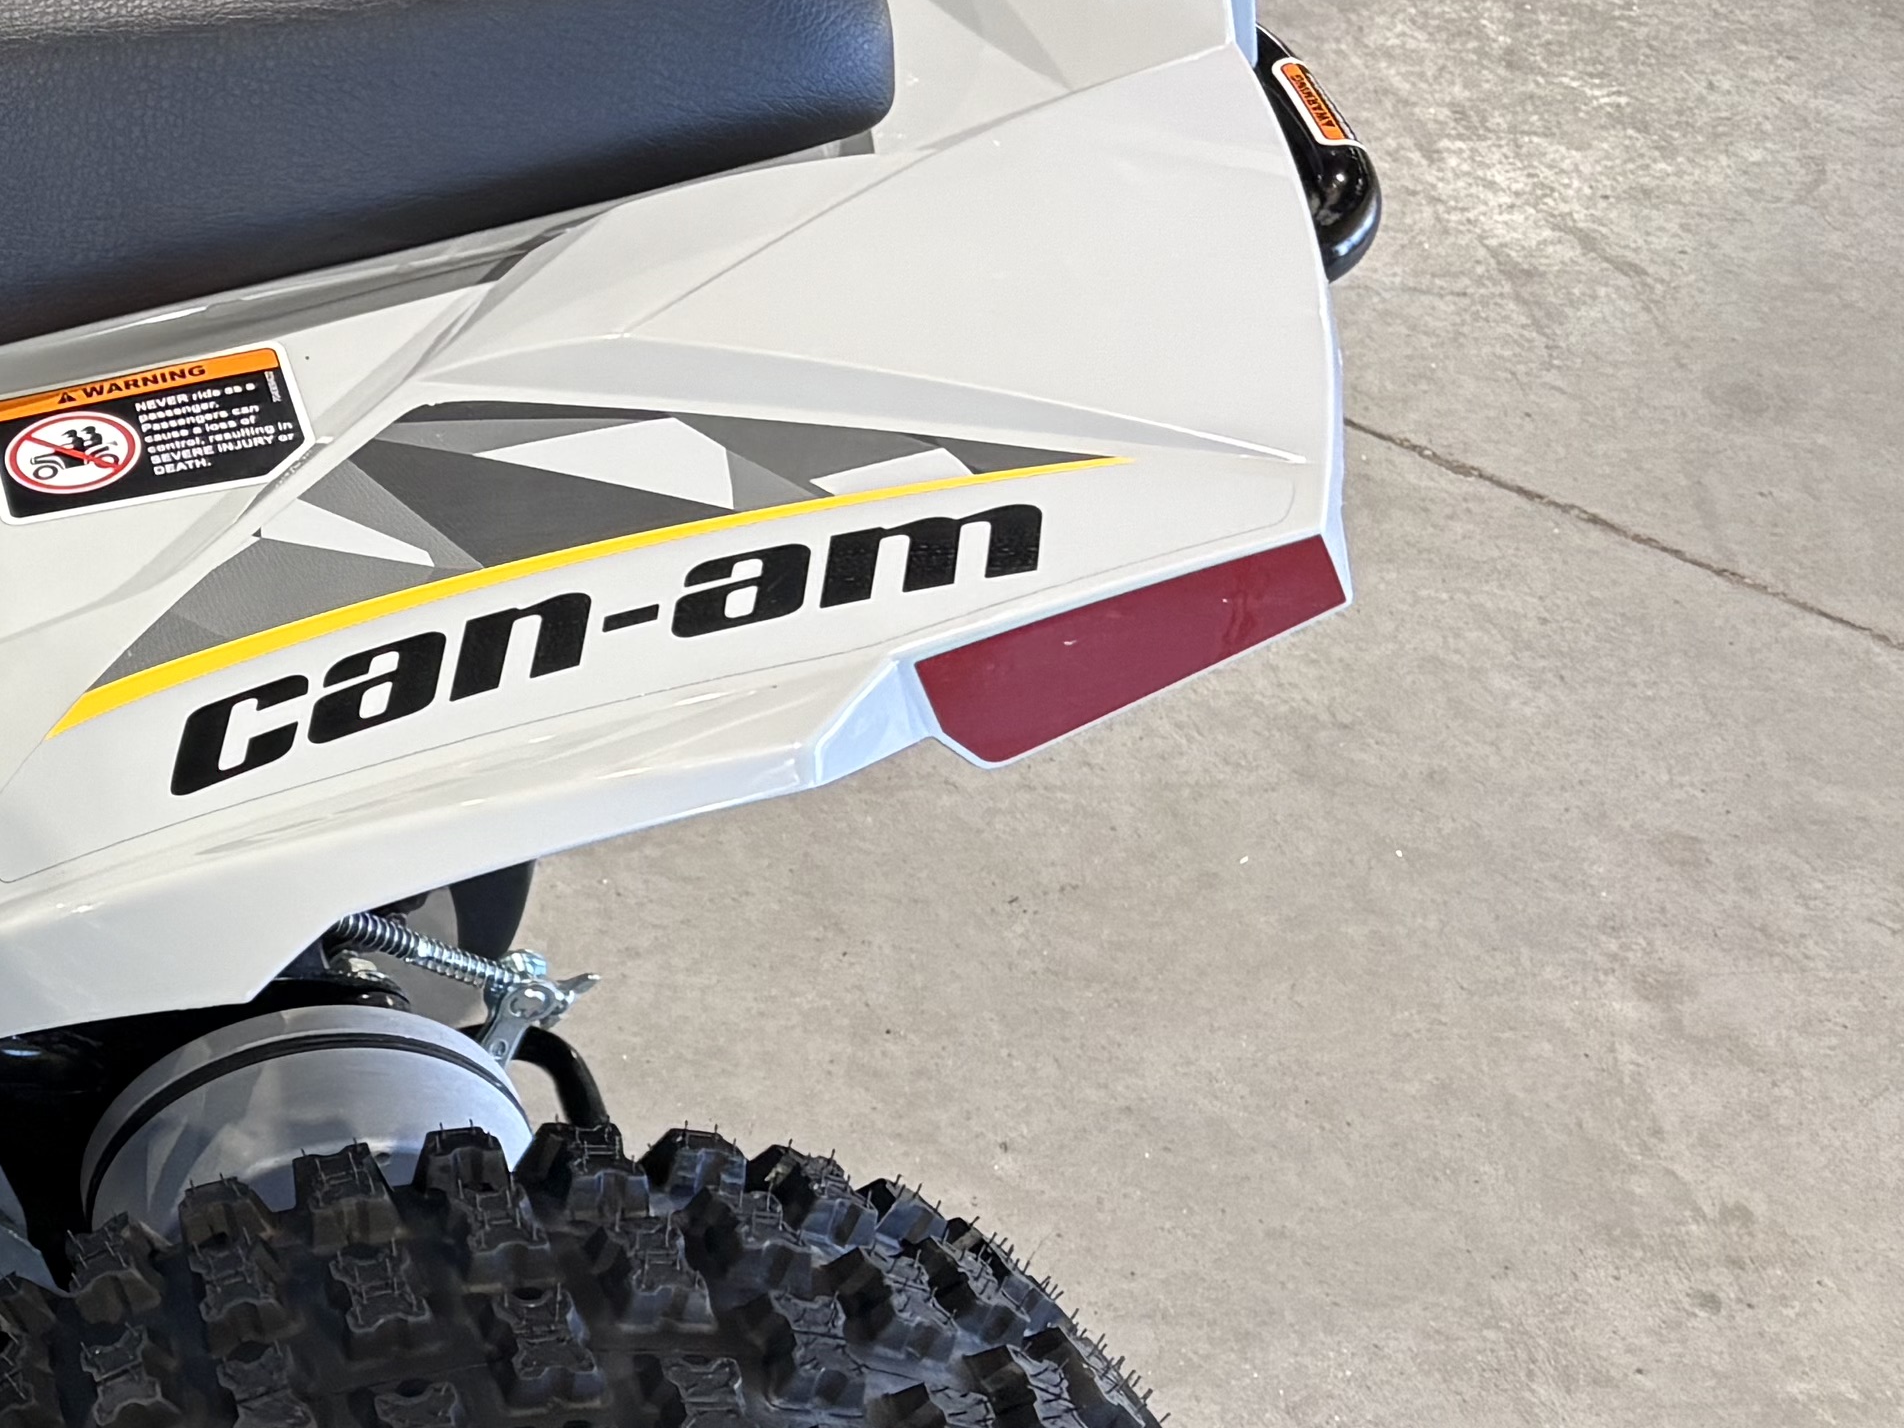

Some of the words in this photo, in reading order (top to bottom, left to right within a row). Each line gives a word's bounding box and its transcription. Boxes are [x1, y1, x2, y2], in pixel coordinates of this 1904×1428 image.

[1288, 74, 1329, 126] WARNING
[81, 366, 206, 399] WARNING
[134, 393, 189, 412] NEVER
[192, 388, 221, 401] ride
[224, 385, 243, 395] as
[246, 382, 256, 391] a
[138, 401, 220, 422] passenger.
[141, 411, 229, 433] Passengers
[232, 404, 259, 415] can
[144, 425, 189, 443] cause
[193, 426, 202, 435] a
[205, 420, 237, 432] loss
[240, 415, 256, 426] of
[147, 437, 205, 454] control,
[208, 425, 275, 444] resulting
[278, 421, 293, 431] in
[150, 445, 214, 465] SEVERE
[217, 435, 274, 454] INJURY
[277, 432, 295, 442] or
[153, 459, 212, 476] DEATH.
[168, 502, 1044, 798] can-am
